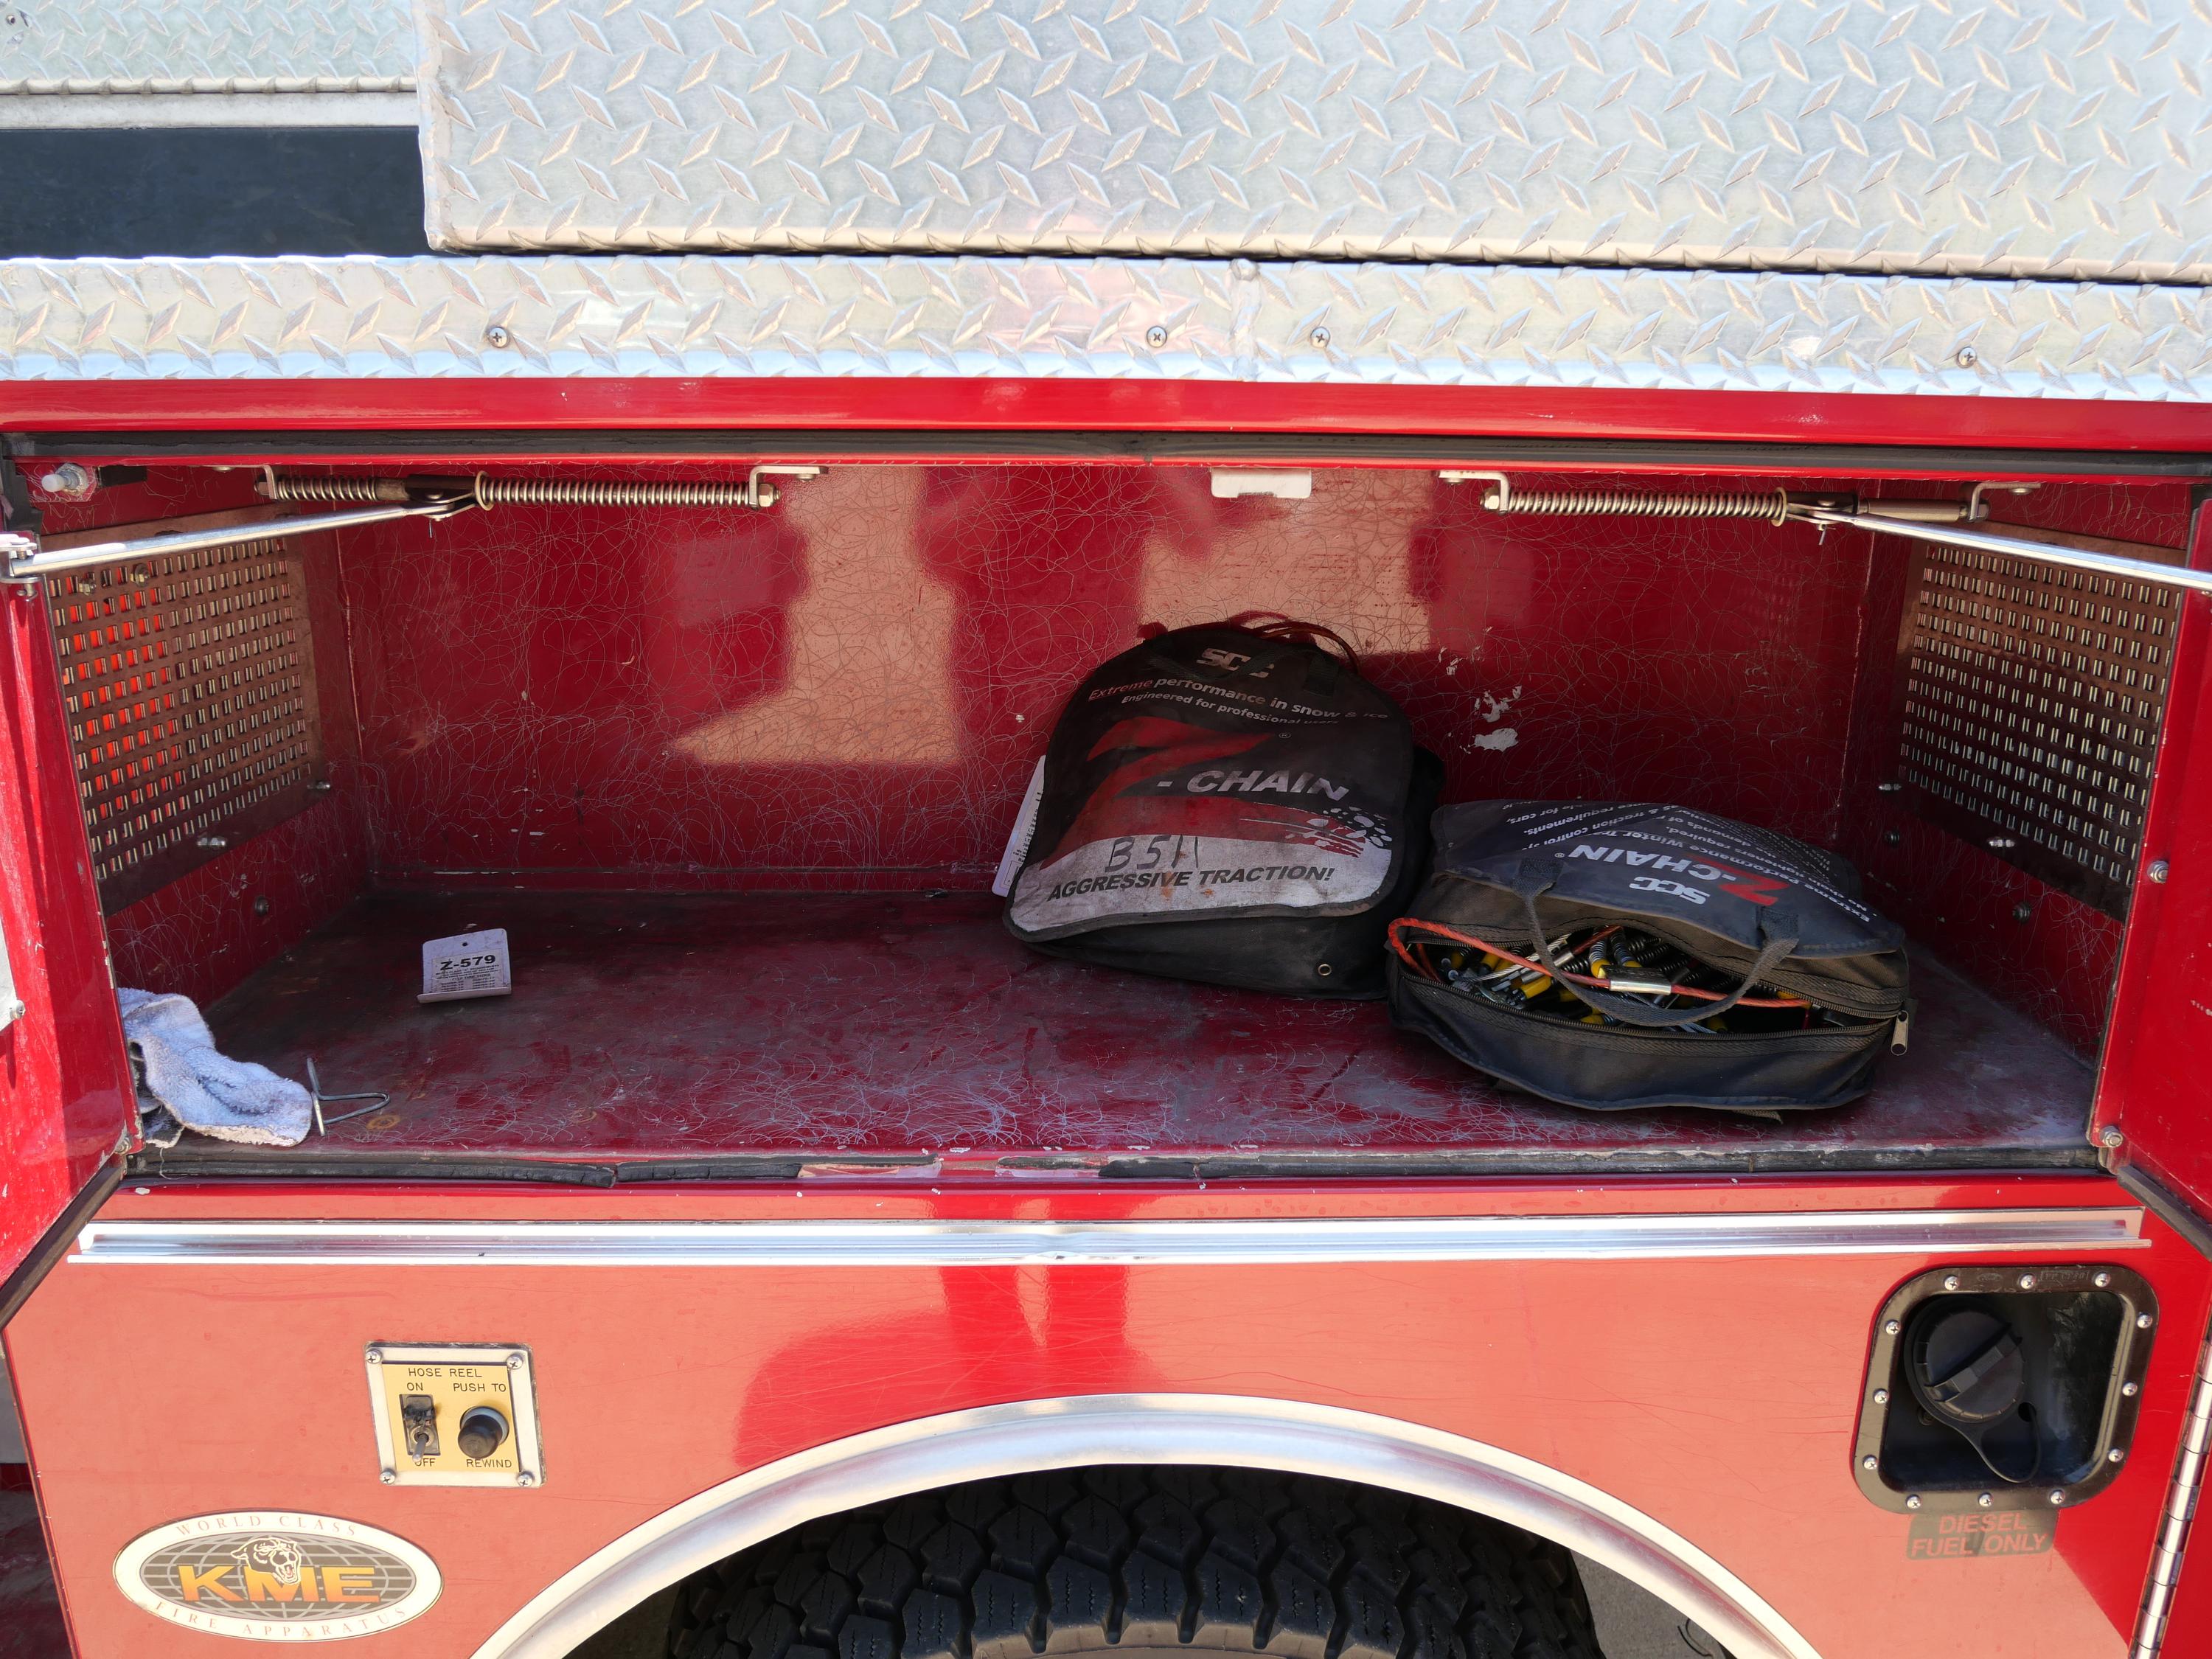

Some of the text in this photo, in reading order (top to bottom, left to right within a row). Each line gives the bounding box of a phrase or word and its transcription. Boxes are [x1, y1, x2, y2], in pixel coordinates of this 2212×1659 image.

[1088, 679, 1154, 702] Extreme
[1153, 678, 1266, 705] performance
[1270, 697, 1288, 710] in
[1291, 703, 1341, 718] snow
[1121, 691, 1192, 704] Engineered
[1195, 698, 1216, 709] for
[1217, 703, 1301, 725] professional
[1539, 807, 1559, 816] for
[1667, 814, 1684, 824] of
[1622, 830, 1684, 848] Winter
[1666, 826, 1731, 849] required.
[1687, 821, 1752, 846] demands
[1689, 845, 1799, 885] Performance
[1047, 866, 1336, 902] AGGRESSIVE TRACTION!
[1629, 876, 1711, 905] SCC
[439, 954, 496, 971] Z-579
[408, 1368, 483, 1378] HOSE REEL
[406, 1382, 424, 1391] ON
[453, 1382, 507, 1392] PUSH TO
[414, 1458, 437, 1467] OFF
[466, 1458, 512, 1468] REWIND
[175, 1515, 357, 1536] WORLD CLASS
[1939, 1512, 2027, 1534] DIESEL
[1911, 1533, 2049, 1557] FUEL ONLY
[178, 1564, 380, 1602] KME
[155, 1601, 406, 1637] FIRE APPARATUS
